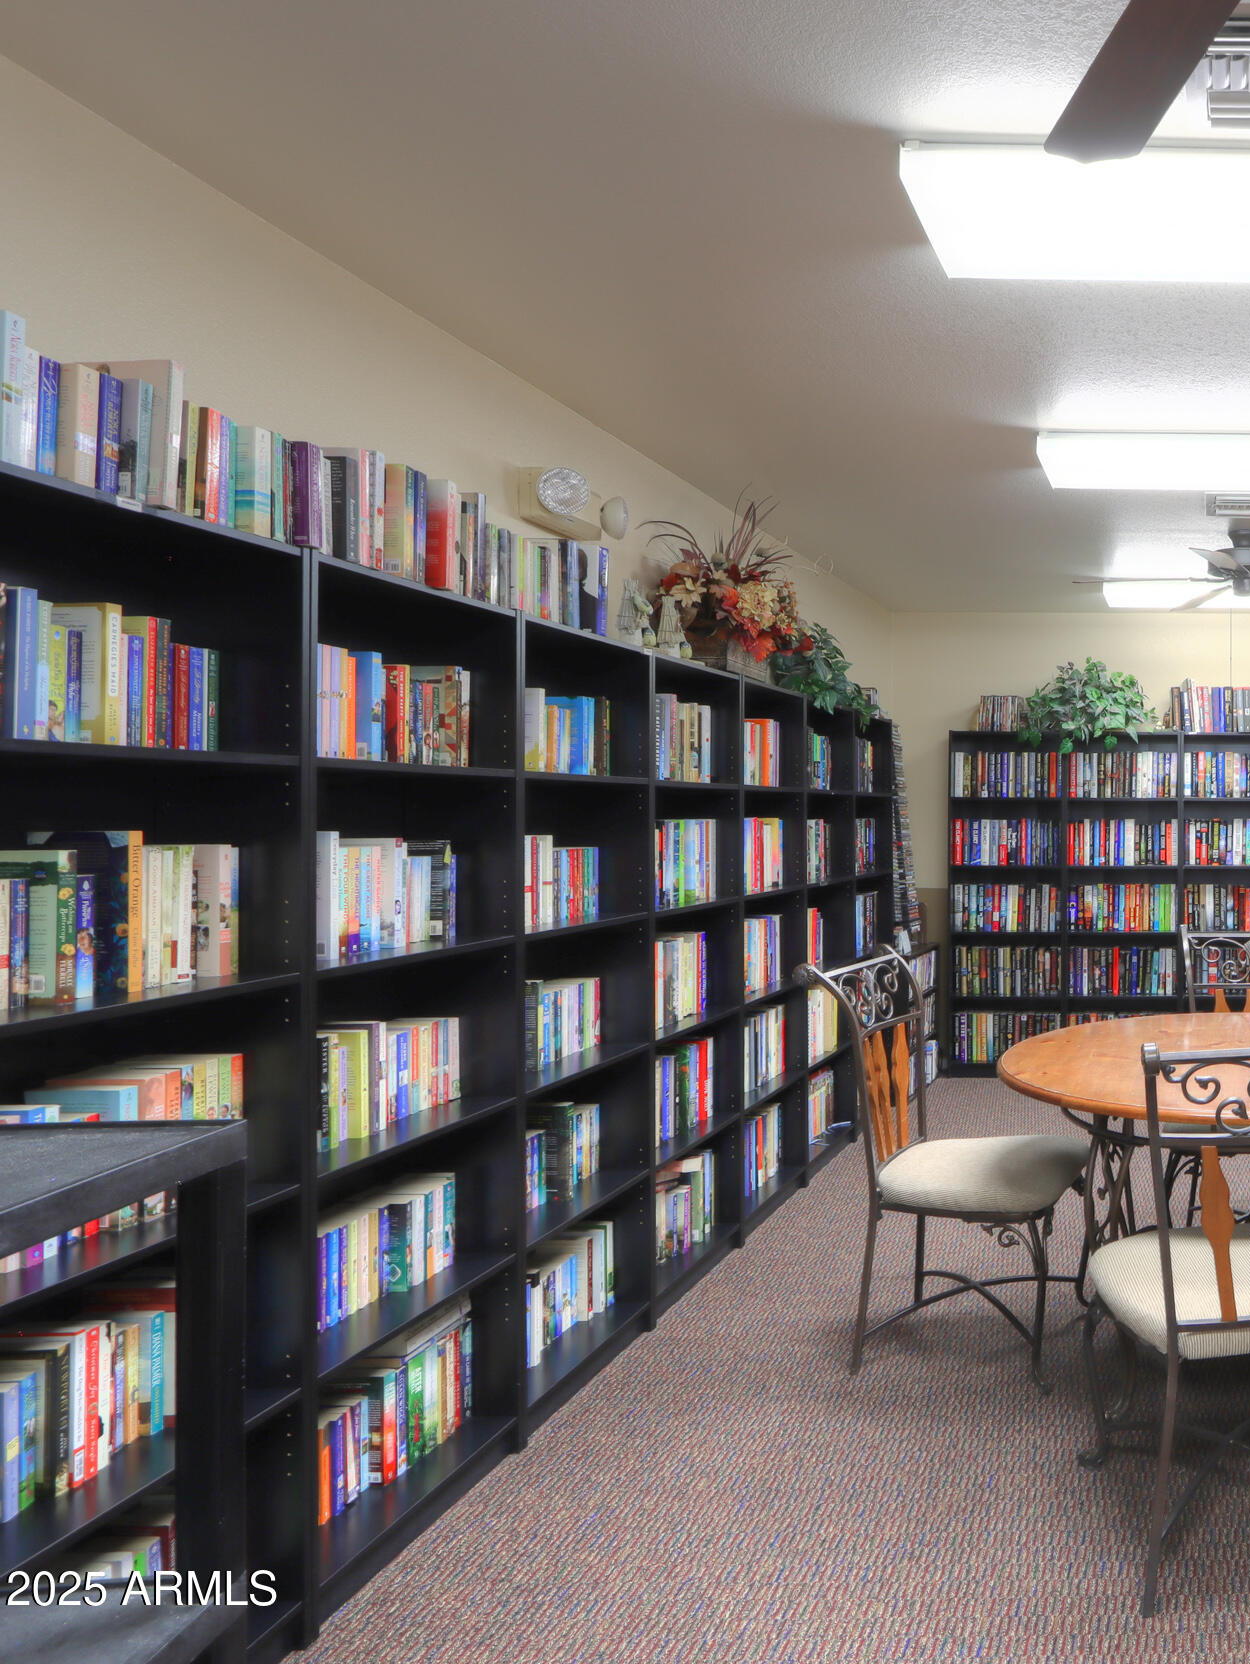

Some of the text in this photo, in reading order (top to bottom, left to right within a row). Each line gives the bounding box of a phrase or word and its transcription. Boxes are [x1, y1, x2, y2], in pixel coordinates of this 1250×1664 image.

[129, 844, 141, 918] Bitter Orange
[66, 898, 75, 922] Wishing
[152, 1332, 161, 1357] DIANA
[90, 1340, 98, 1381] Christmas
[151, 1358, 161, 1387] PALMER
[413, 1367, 422, 1393] AFTER
